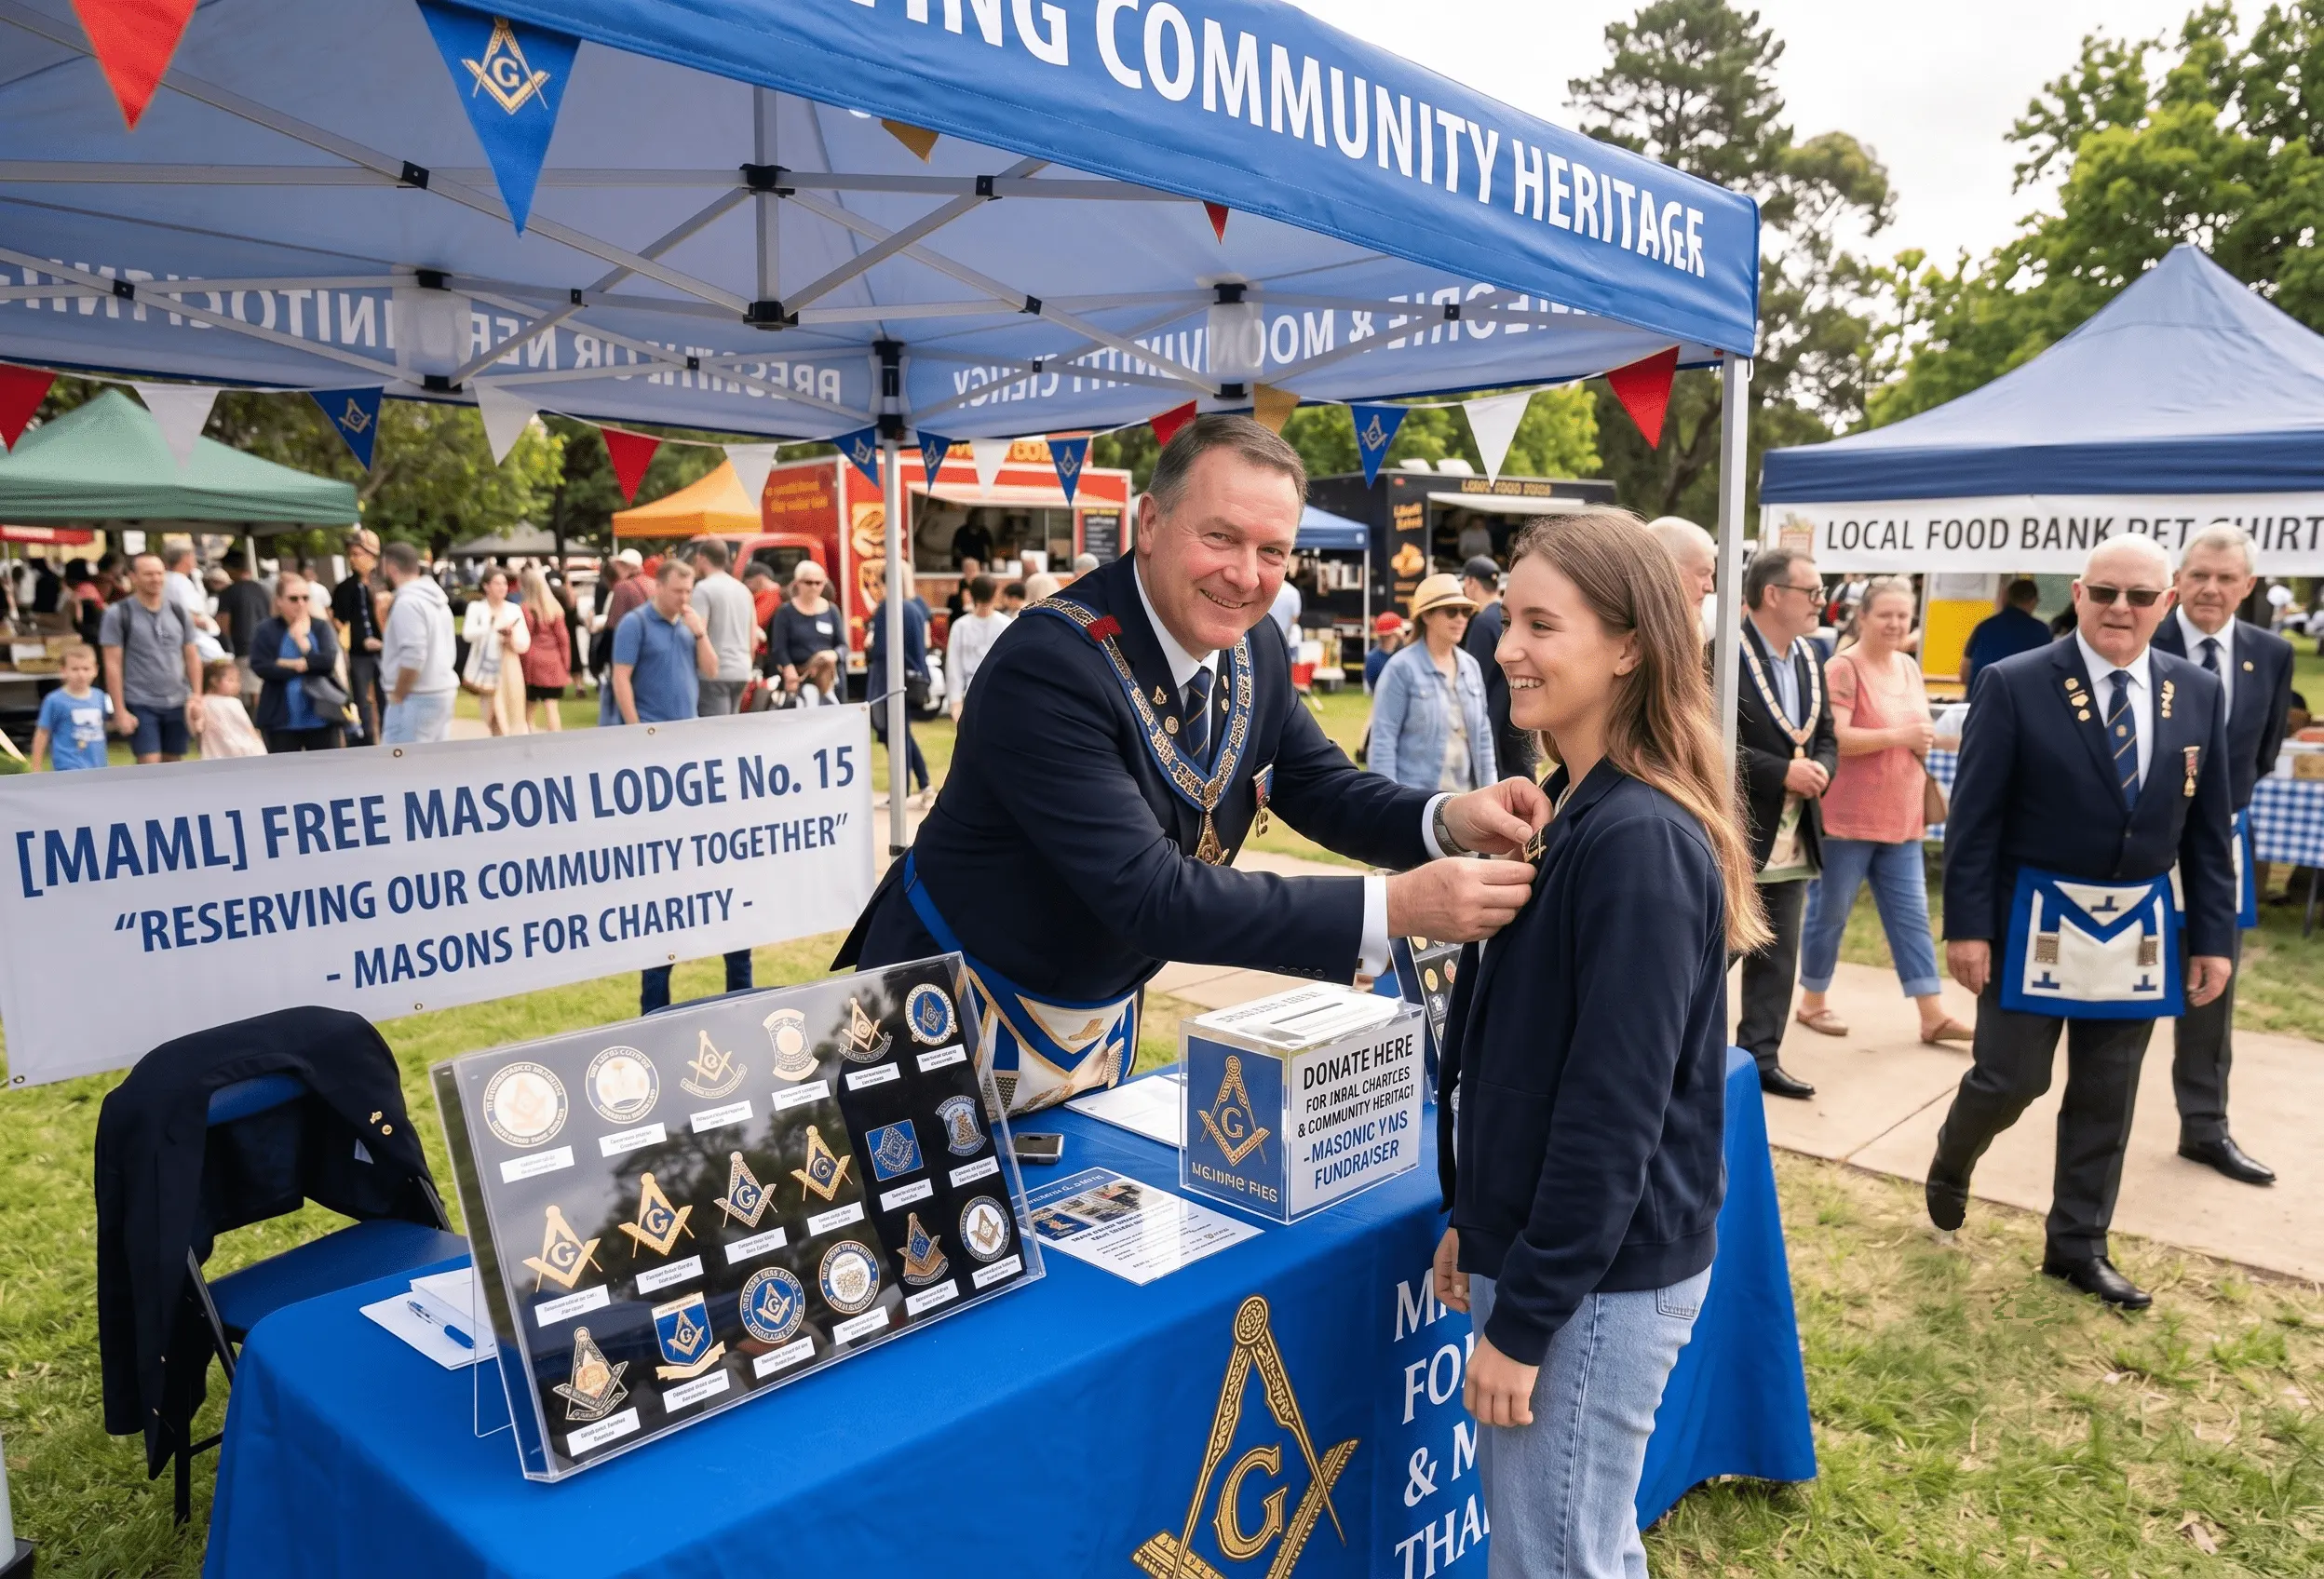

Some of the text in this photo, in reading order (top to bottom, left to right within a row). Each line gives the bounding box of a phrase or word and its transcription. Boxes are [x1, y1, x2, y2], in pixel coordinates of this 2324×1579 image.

[1096, 0, 1499, 205] COMMUNITY
[1827, 520, 1915, 550] LOCAL
[1926, 519, 2009, 549] FOOD
[2020, 517, 2114, 550] BANK
[16, 745, 855, 898] [MAML] FREE MASON LODGE No. 15
[388, 869, 468, 914] OUR
[479, 839, 684, 900] COMMUNITY
[355, 925, 513, 990] MASONS
[524, 914, 590, 958] FOR
[600, 887, 734, 943] CHARITY
[1304, 1033, 1413, 1090] DONATE HERE
[1298, 1123, 1306, 1138] &
[1308, 1099, 1371, 1135] COMMUNITY
[1306, 1093, 1327, 1113] FOR
[1315, 1139, 1399, 1190] FUNDRAISER
[1394, 1268, 1448, 1343] M
[1213, 1445, 1288, 1559] G
[1403, 1446, 1439, 1508] &
[1394, 1493, 1491, 1579] THA
